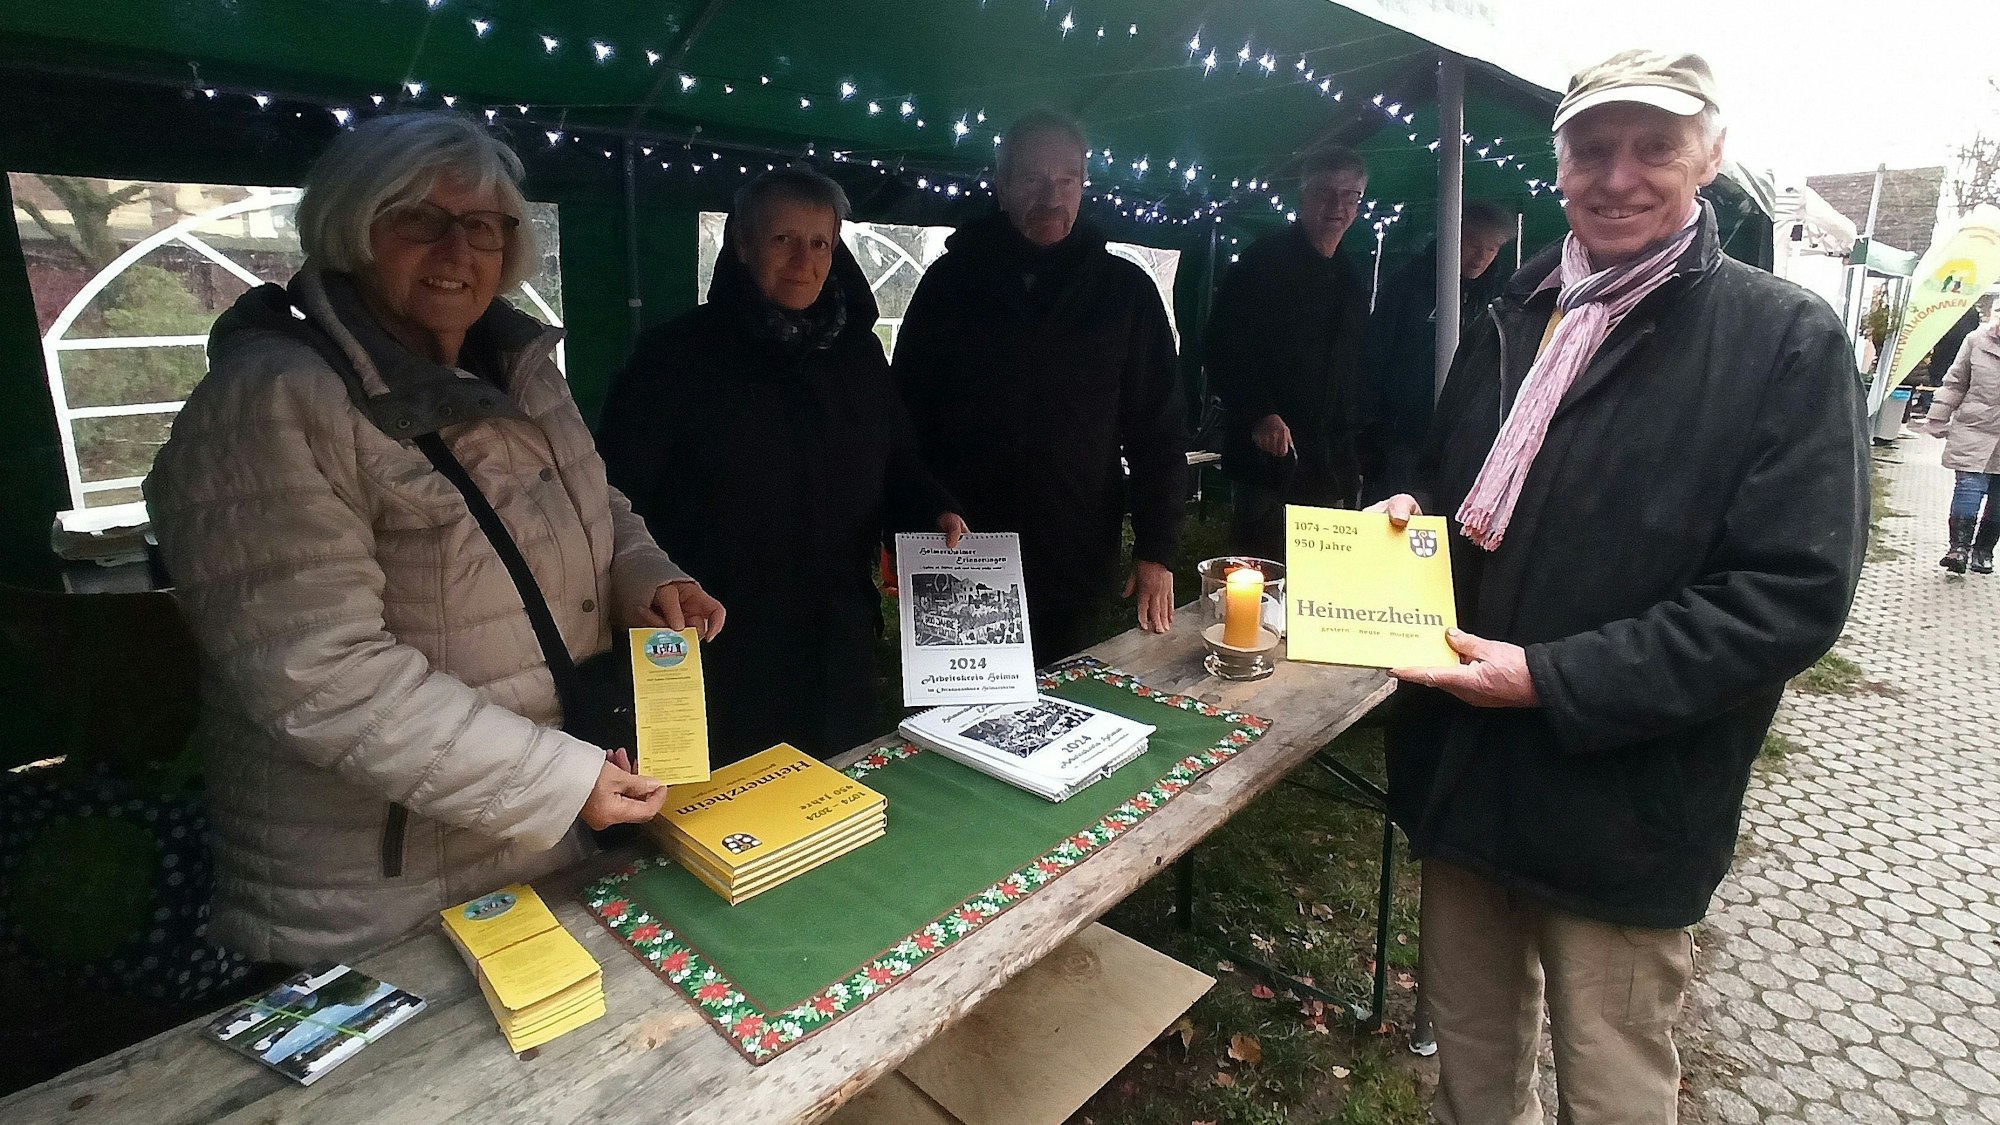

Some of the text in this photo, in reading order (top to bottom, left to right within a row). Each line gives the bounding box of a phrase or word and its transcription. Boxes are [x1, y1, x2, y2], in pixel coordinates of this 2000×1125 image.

[1294, 521, 1319, 532] 1074
[1332, 524, 1358, 535] 2024
[1294, 538, 1352, 552] 950 Jahre
[1296, 599, 1444, 627] Heimerzheim
[949, 657, 987, 670] 2024
[1061, 735, 1092, 753] 2024
[676, 760, 812, 815] Heimerzheim
[799, 784, 854, 810] 950 Jahre
[840, 791, 866, 804] 1074
[805, 806, 833, 820] 2024
